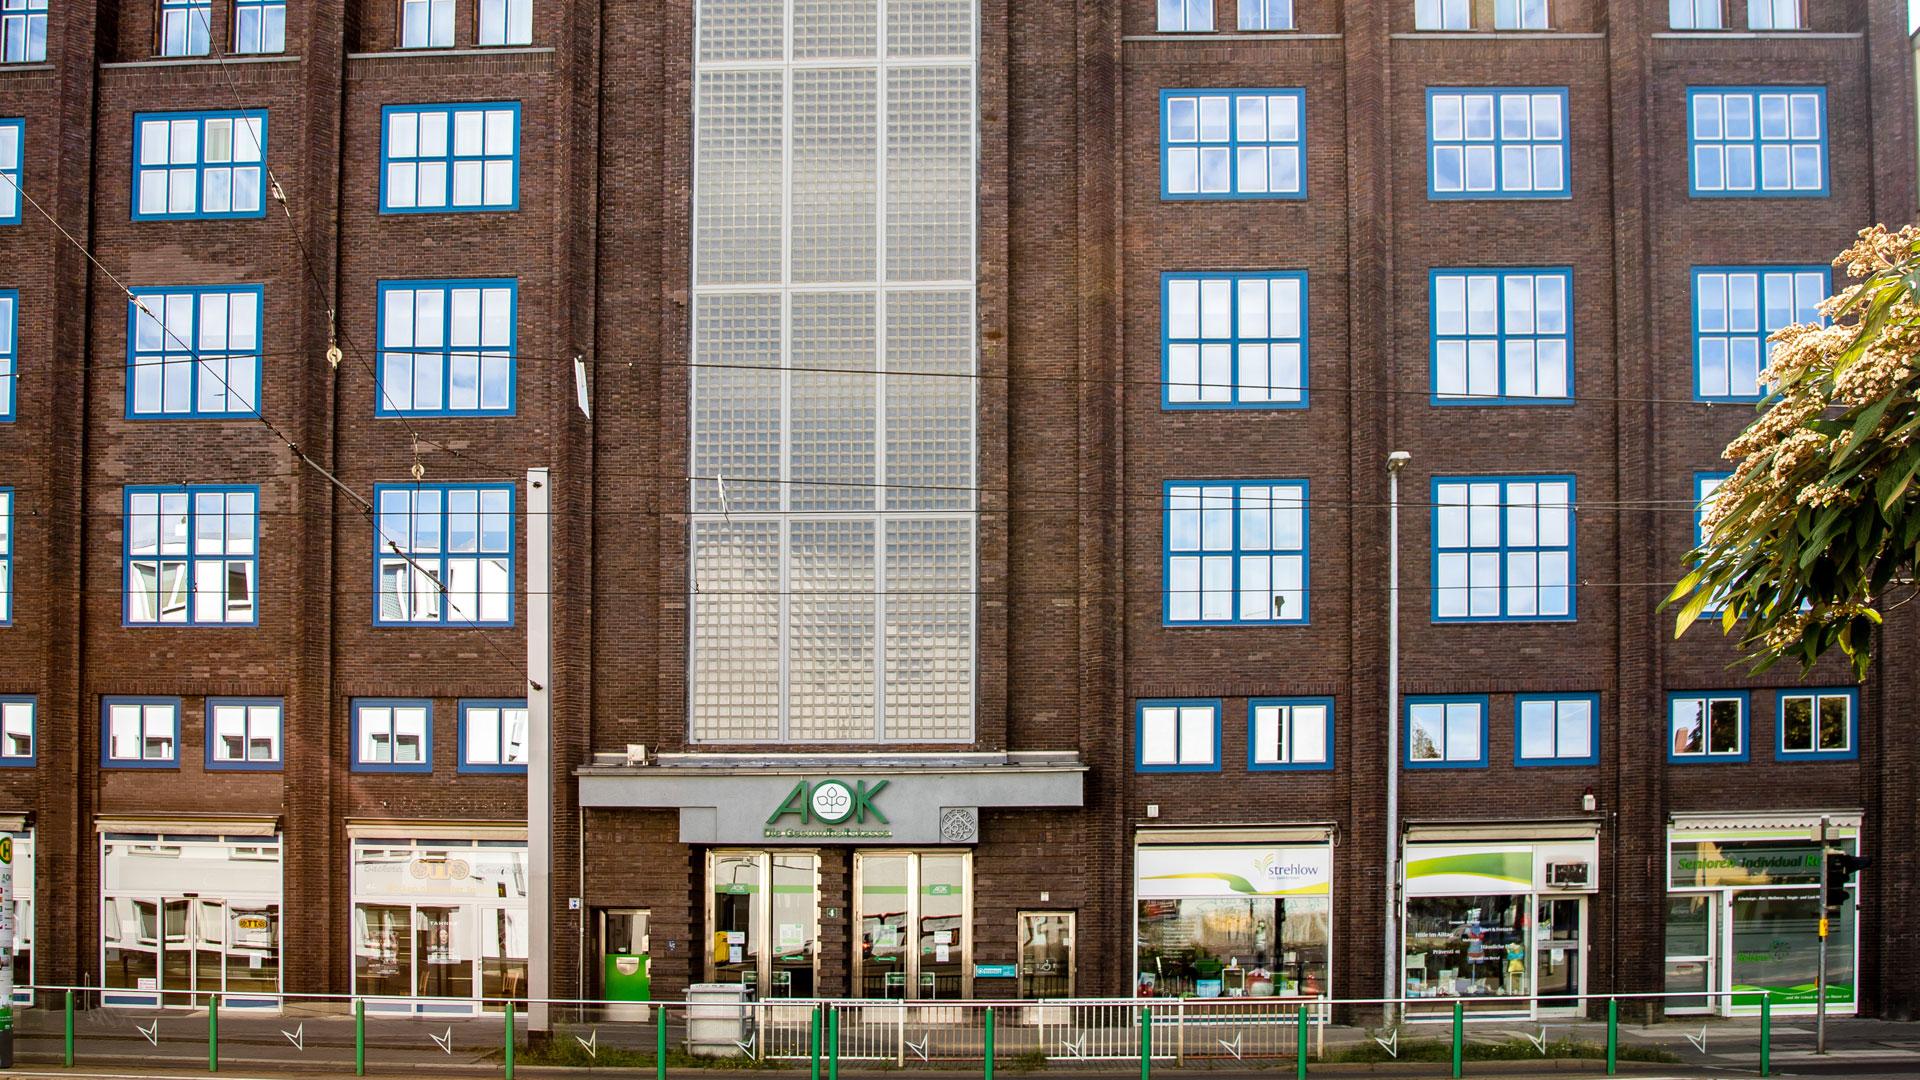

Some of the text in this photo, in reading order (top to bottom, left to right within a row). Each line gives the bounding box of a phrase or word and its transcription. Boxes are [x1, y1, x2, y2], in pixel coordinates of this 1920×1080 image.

[766, 779, 890, 825] AOK
[1741, 855, 1803, 868] Individual
[1268, 863, 1319, 875] strehlow
